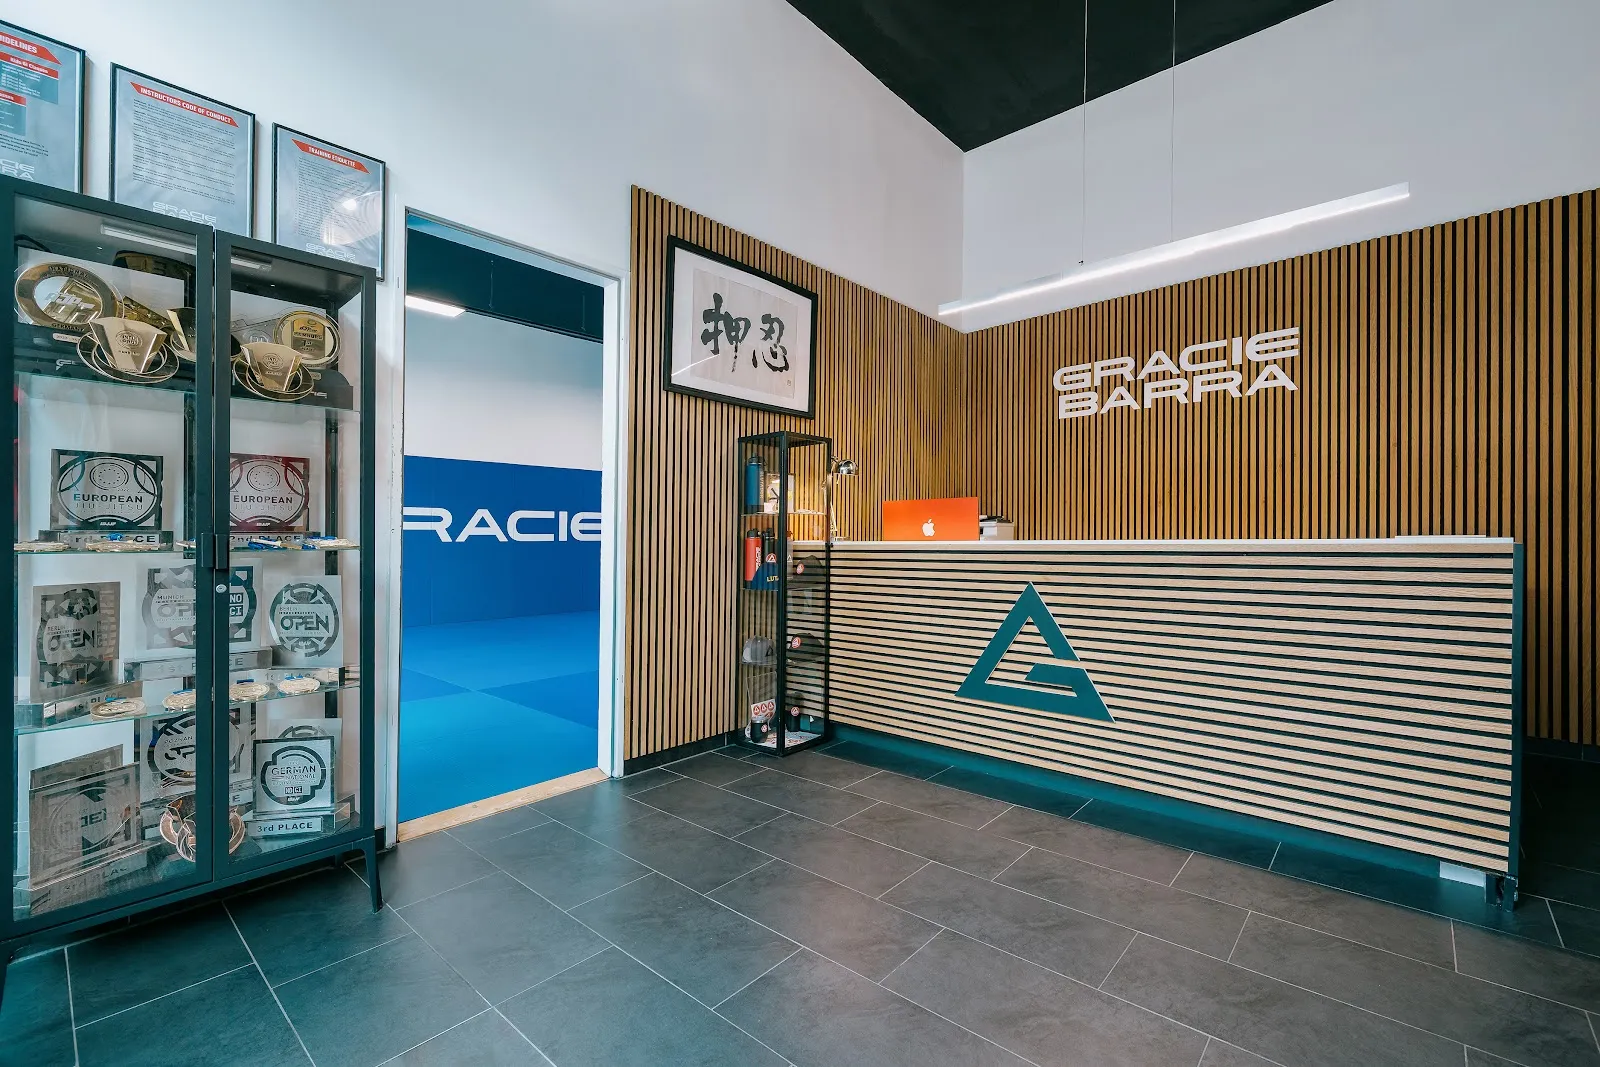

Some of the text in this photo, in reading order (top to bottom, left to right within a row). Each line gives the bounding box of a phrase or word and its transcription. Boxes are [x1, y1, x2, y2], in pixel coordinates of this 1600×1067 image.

[140, 87, 231, 124] INSTRUCTORS CODE OF CONDUCT
[308, 146, 356, 168] TRAINING ETIQUETTE
[153, 201, 217, 223] GRACIE
[1053, 327, 1299, 392] GRACIE
[1059, 364, 1298, 419] BARRA
[73, 494, 143, 503] EUROPEAN
[233, 495, 293, 504] EUROPEAN
[229, 594, 243, 603] NO
[281, 613, 330, 634] OPEN
[48, 630, 94, 652] OPEN
[271, 765, 316, 775] GERMAN
[257, 822, 313, 833] 3rd PLACE
